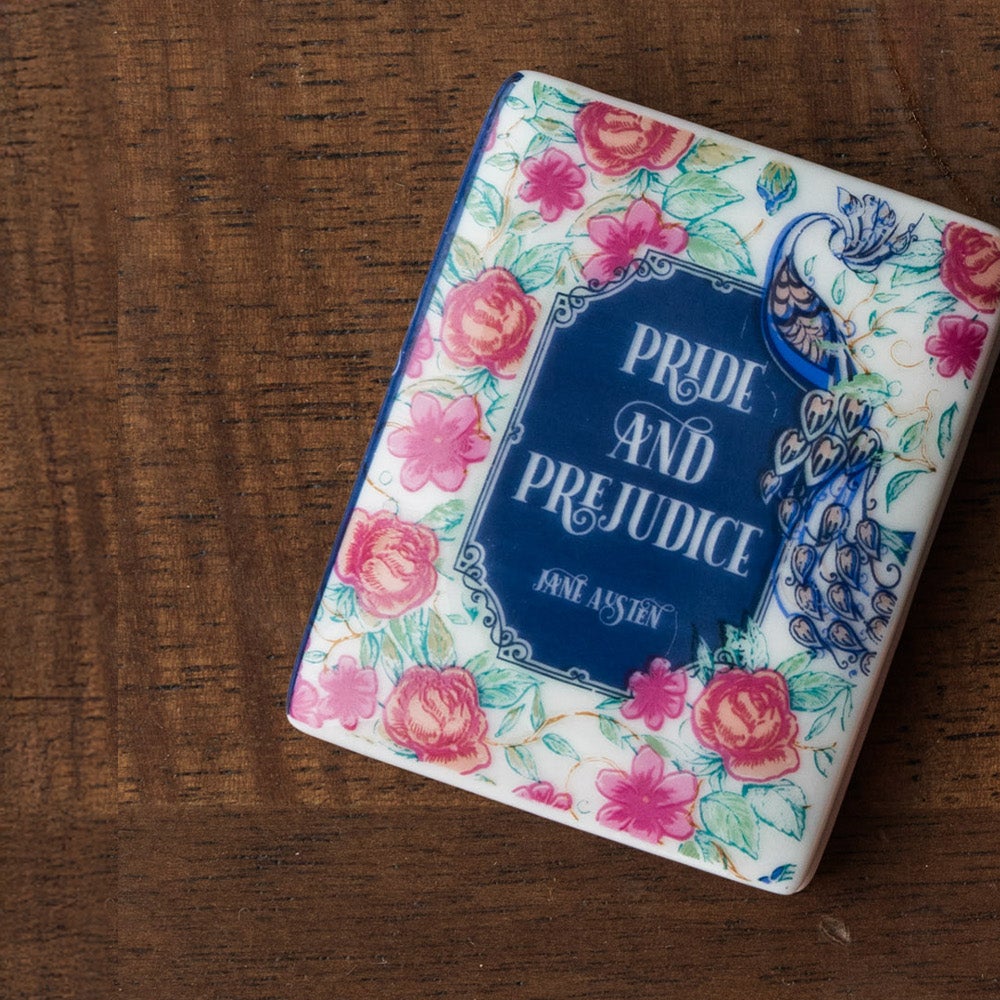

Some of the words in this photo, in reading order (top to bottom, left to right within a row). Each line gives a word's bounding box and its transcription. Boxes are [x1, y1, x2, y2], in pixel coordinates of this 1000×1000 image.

[619, 321, 768, 413] PRIDE
[606, 400, 716, 485] AND
[511, 450, 764, 578] PREJUDICE
[532, 567, 588, 604] JANE
[586, 586, 675, 629] AUSTEN
